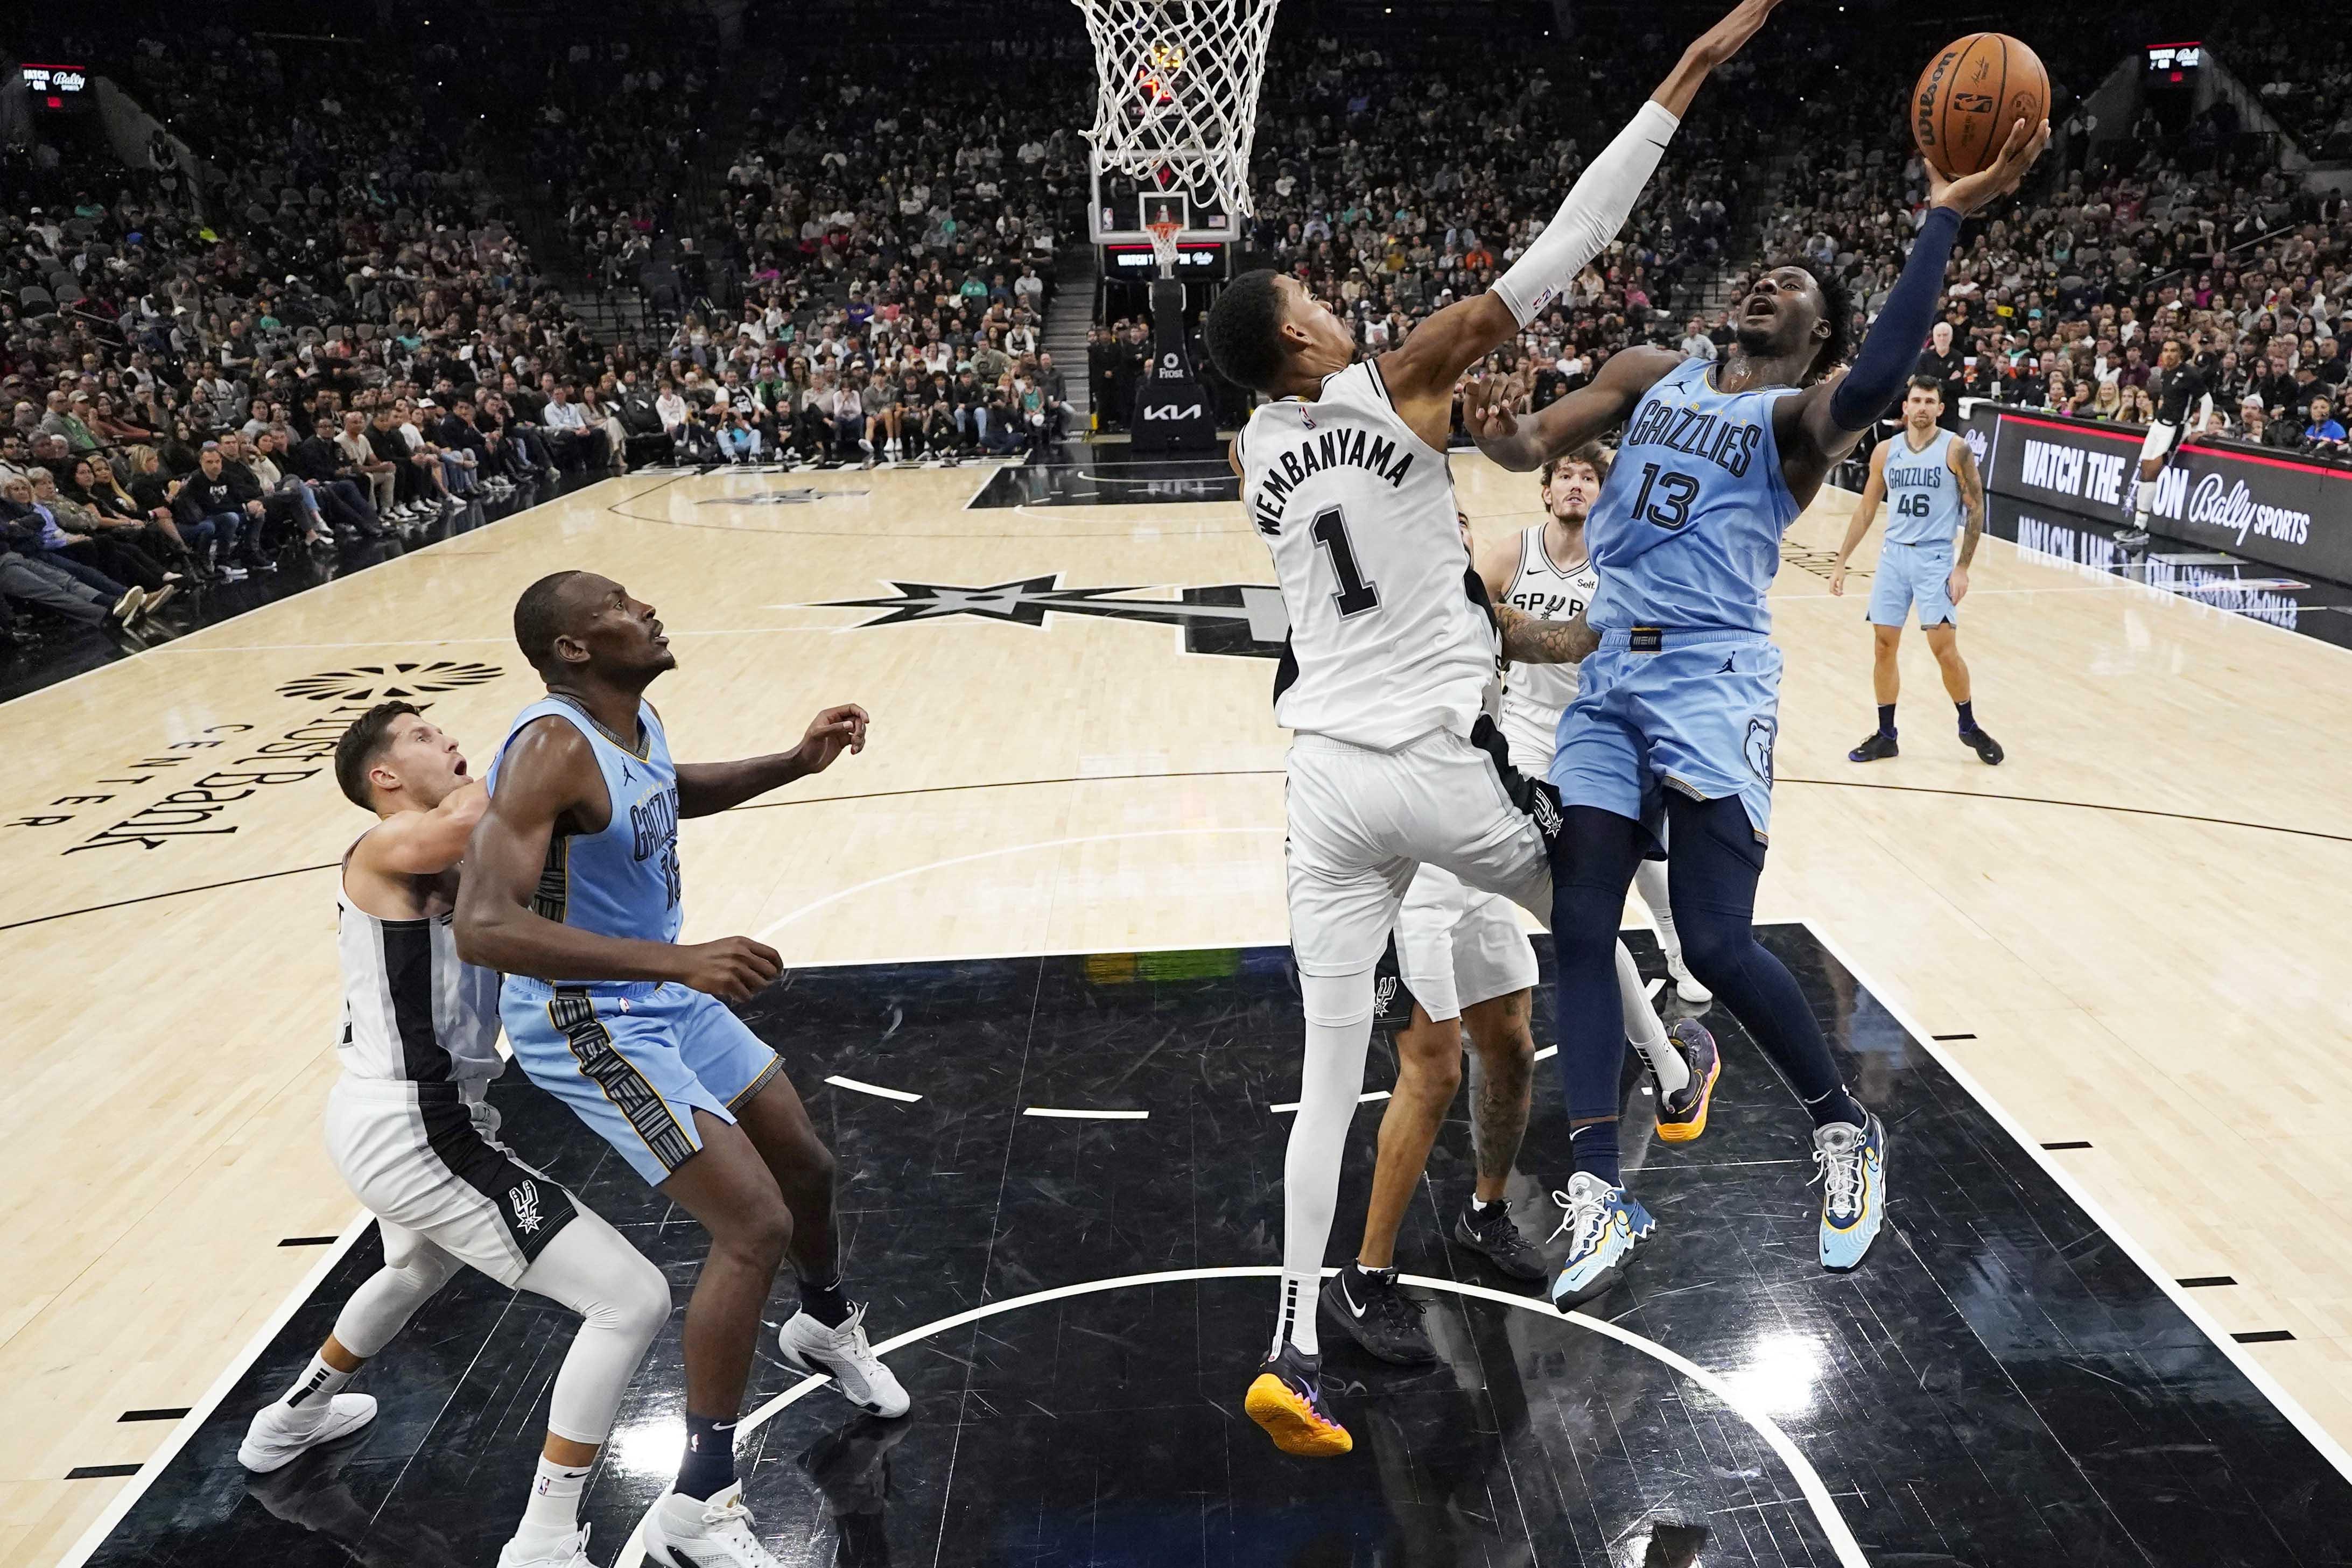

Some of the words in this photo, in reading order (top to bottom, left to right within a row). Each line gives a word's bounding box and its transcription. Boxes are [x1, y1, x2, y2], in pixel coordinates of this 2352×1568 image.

[53, 72, 85, 89] Bally
[1159, 367, 1184, 379] Frost
[1628, 399, 1762, 478] GRIZZLIES
[1256, 428, 1414, 536] WEMBANYAMA
[1631, 462, 1700, 531] 13
[1888, 466, 1941, 489] GRIZZLIES
[1897, 494, 1930, 517] 46
[2022, 439, 2085, 496] WATCH
[2084, 451, 2126, 505] THE
[2153, 466, 2189, 520] ON
[2188, 473, 2257, 546] Bally
[2254, 504, 2311, 545] SPORTS
[1309, 503, 1383, 623] 1
[1577, 579, 1596, 590] Self.
[4, 723, 254, 827] CENTER
[60, 768, 323, 856] Bank
